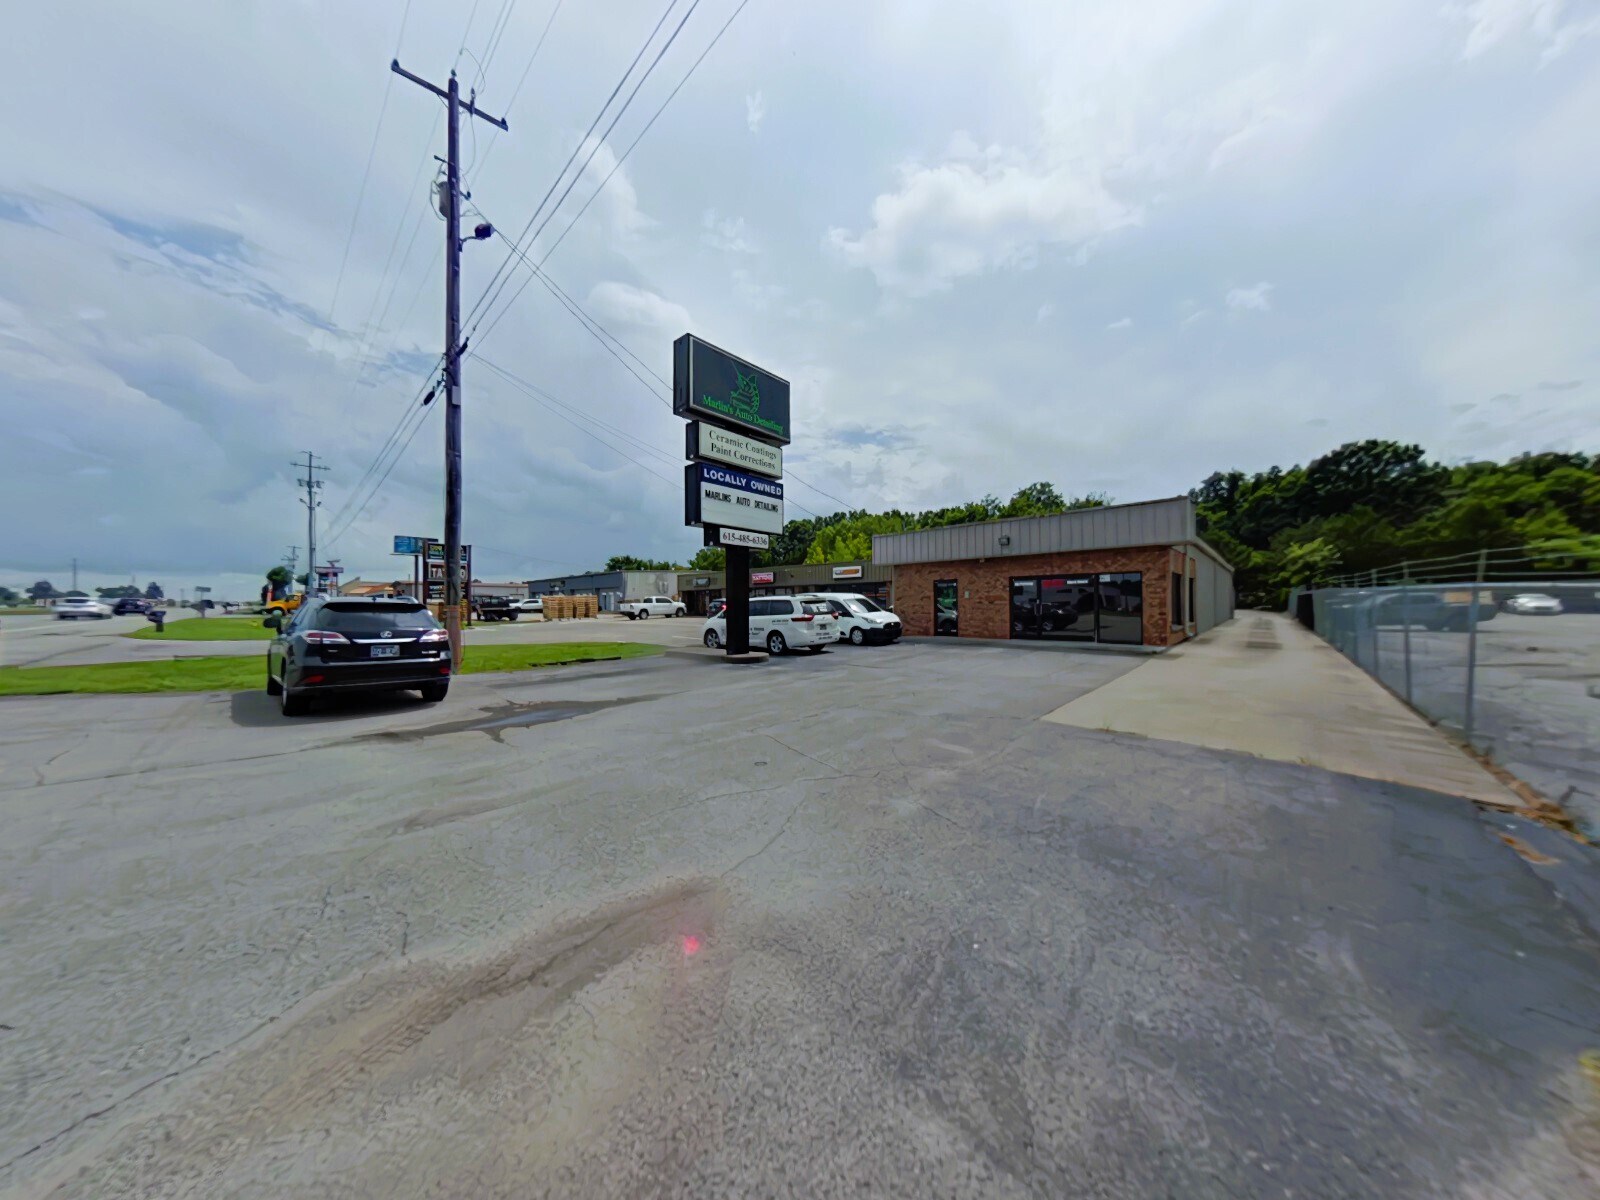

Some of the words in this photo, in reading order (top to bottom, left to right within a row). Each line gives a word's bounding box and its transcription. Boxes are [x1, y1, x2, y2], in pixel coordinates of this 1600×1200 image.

[703, 395, 733, 414] Marlin's
[735, 408, 753, 422] Auto
[709, 430, 743, 449] Ceramic
[745, 441, 777, 460] Coatings
[711, 442, 732, 457] Paint
[734, 450, 776, 470] Corrections
[704, 468, 747, 487] LOCALLY
[750, 481, 782, 496] OWNED
[705, 489, 732, 503] MARLINS
[736, 497, 751, 507] AUTO
[754, 500, 779, 513] DETAILING
